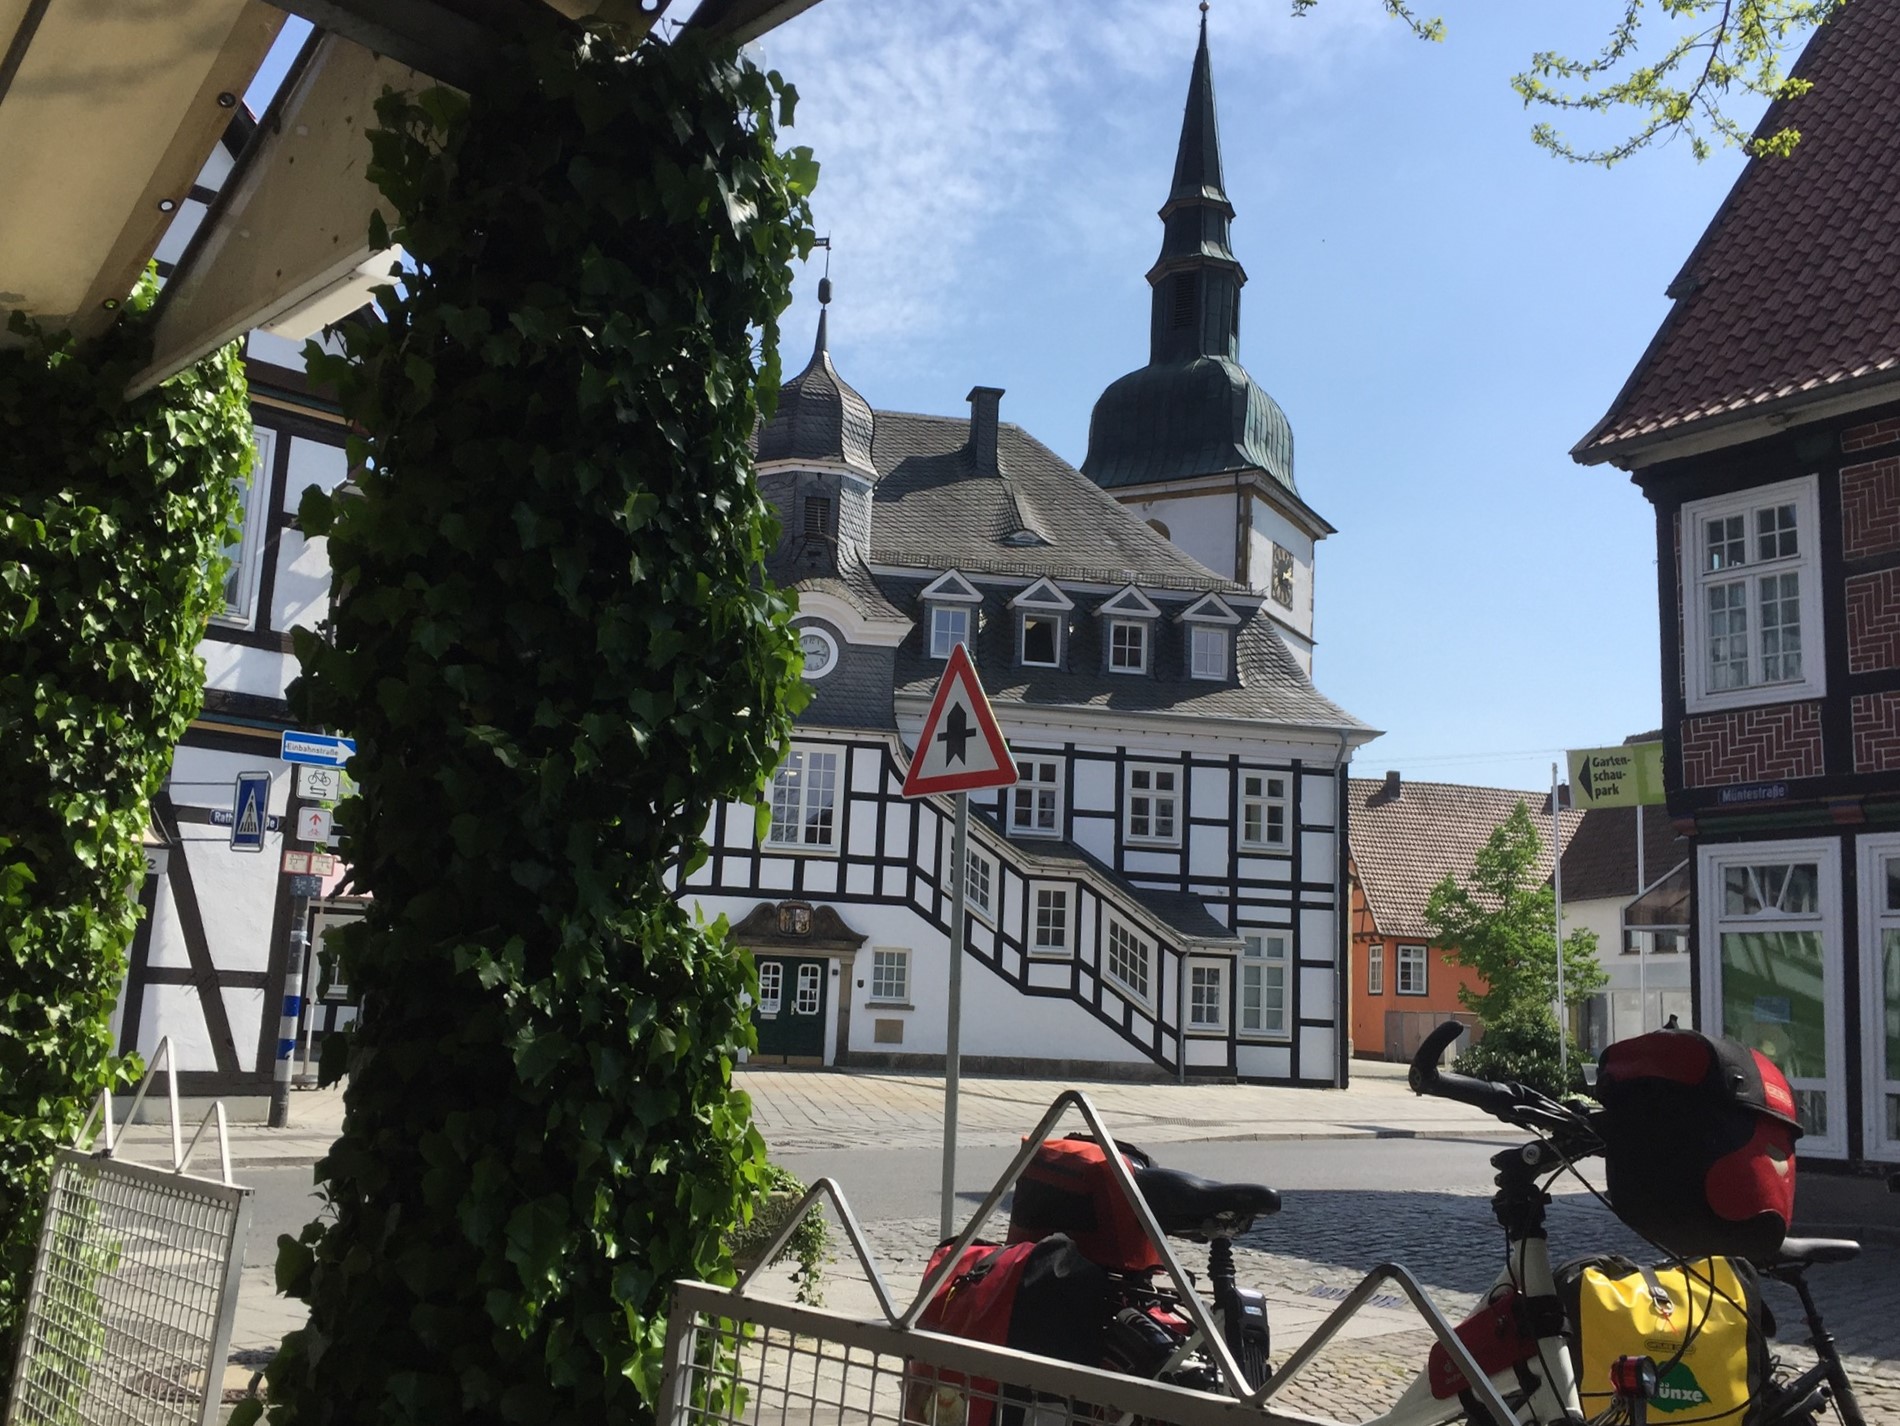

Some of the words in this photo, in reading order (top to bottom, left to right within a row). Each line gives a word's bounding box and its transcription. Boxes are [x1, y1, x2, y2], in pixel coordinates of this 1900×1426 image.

[287, 742, 339, 756] Einbahnstraße
[1592, 755, 1632, 768] Garten-
[1593, 769, 1627, 783] schau-
[1595, 782, 1620, 800] park
[1722, 785, 1785, 803] Müntestraße
[1658, 1381, 1704, 1403] ünxe
